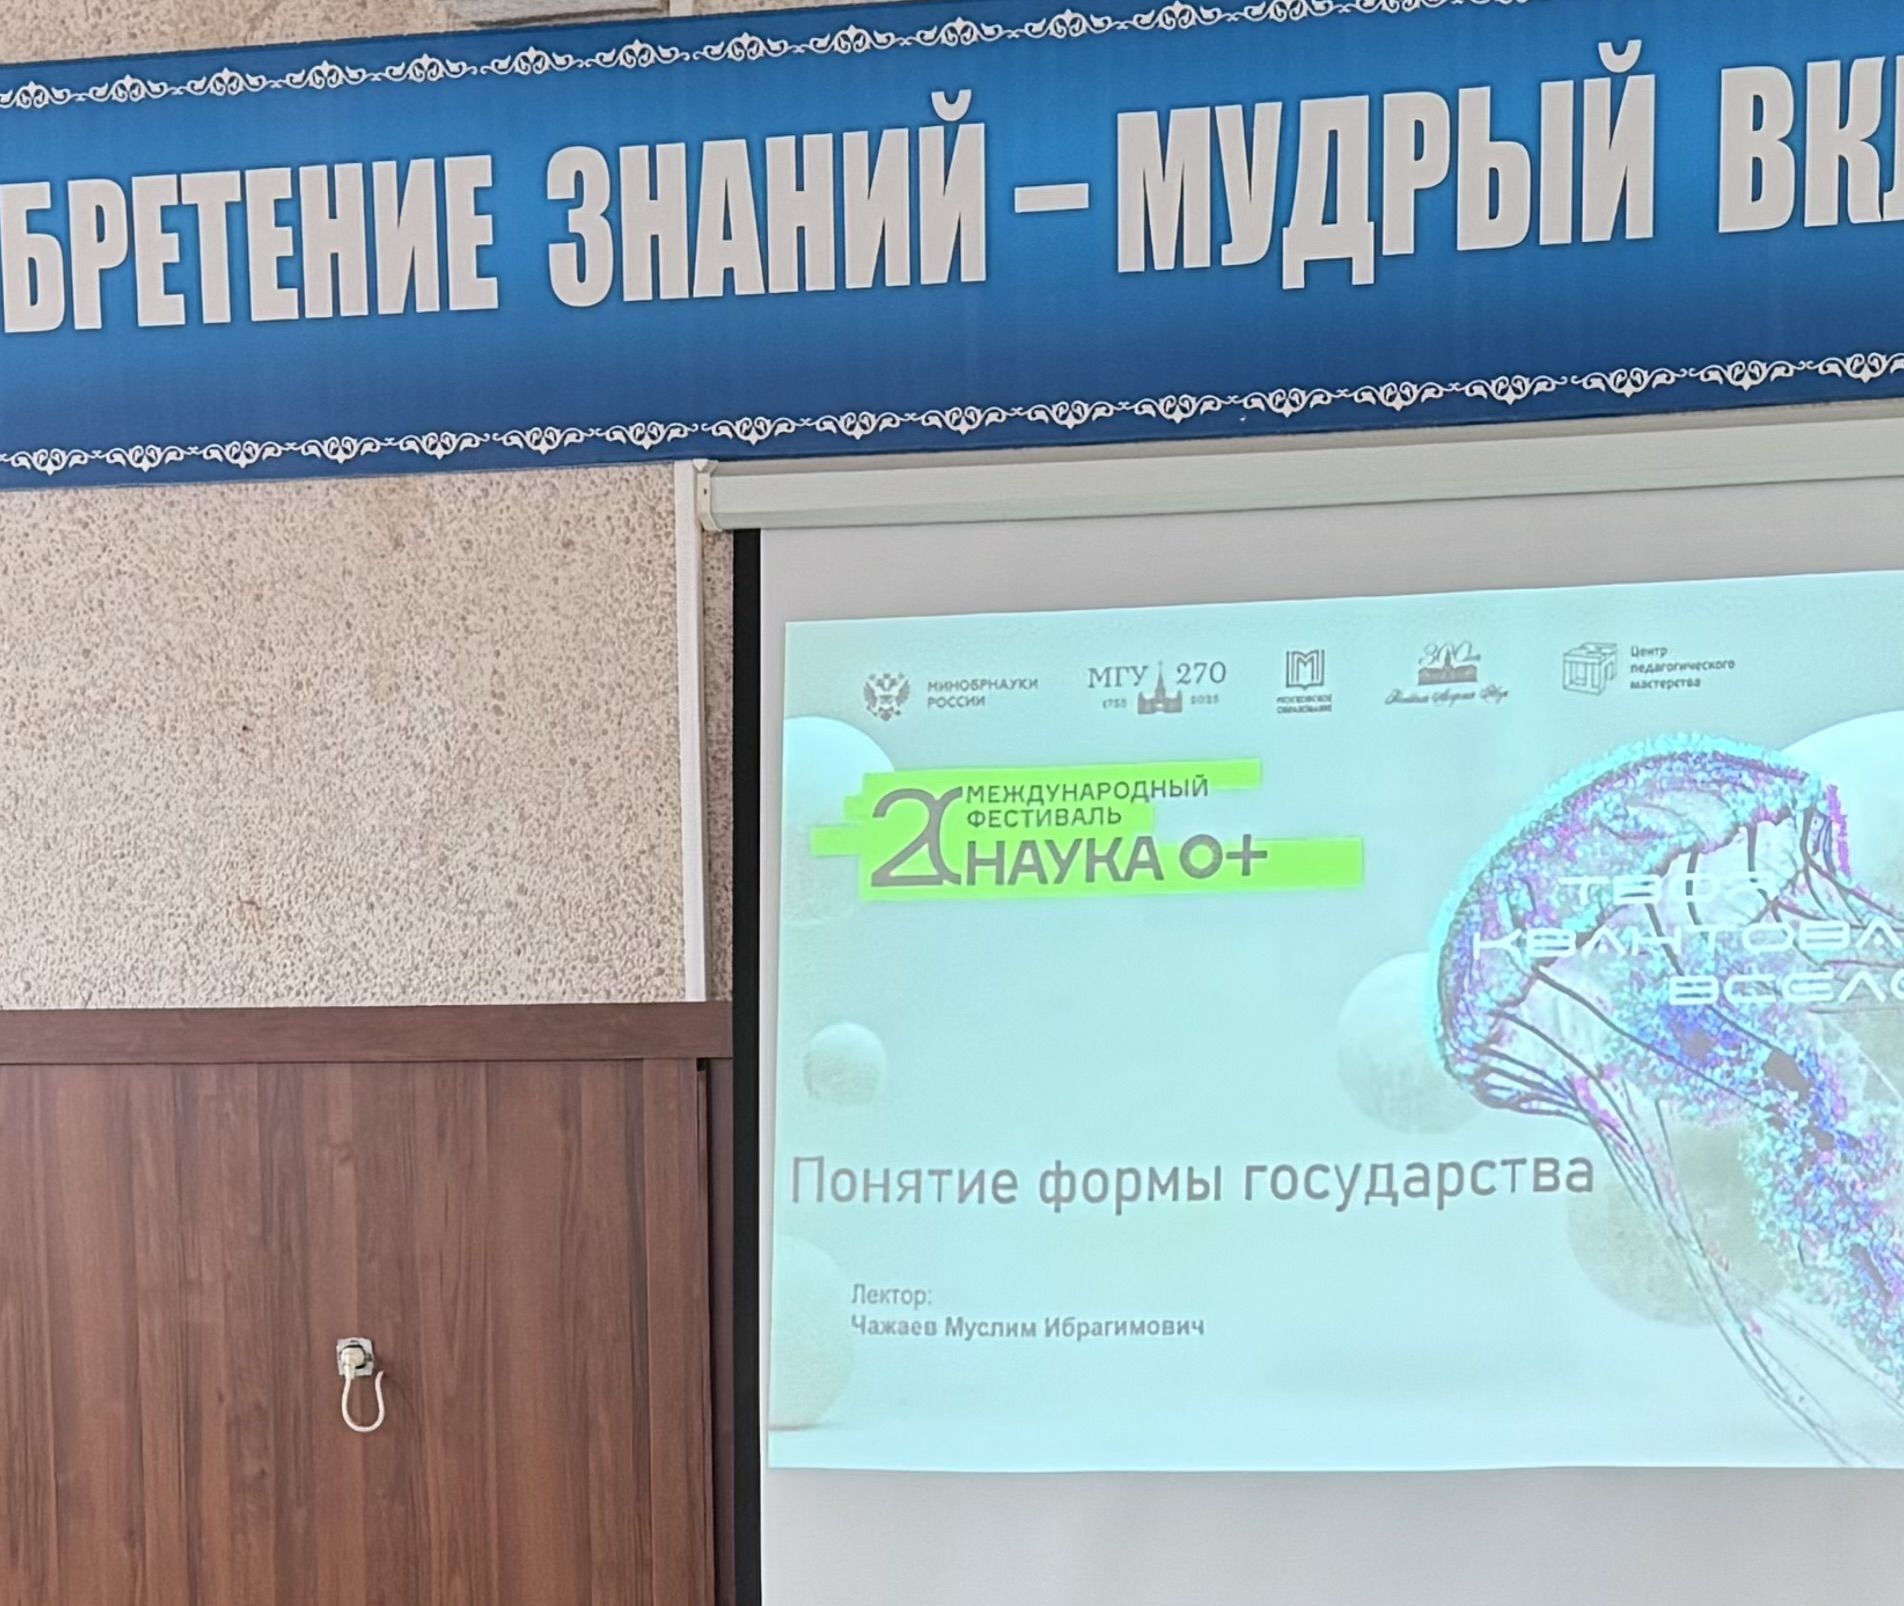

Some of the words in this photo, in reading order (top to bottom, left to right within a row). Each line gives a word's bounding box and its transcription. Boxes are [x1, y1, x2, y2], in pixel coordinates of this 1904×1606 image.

[547, 89, 986, 307] ЗНАНИЙ
[1117, 39, 1655, 290] МУДРЫЙ
[1630, 645, 1669, 658] Центр
[1088, 666, 1149, 688] МГУ
[1176, 660, 1228, 686] 270
[1630, 659, 1737, 674] педагогического
[927, 677, 1039, 692] МИНОБРНАУКИ
[1630, 677, 1702, 690] мастерства
[927, 695, 986, 709] РОССИИ
[965, 774, 1209, 806] МЕЖДУНАРОДНЫЙ
[966, 806, 1122, 829] ФЕСТИВАЛЬ
[965, 835, 1165, 887] НАУКА
[791, 1155, 1019, 1205] Понятие
[1038, 1159, 1223, 1217] формы
[1244, 1154, 1595, 1213] государства
[850, 1283, 932, 1310] Лектор:
[850, 1314, 938, 1337] Чажаев
[944, 1316, 1037, 1341] Муслим
[1044, 1316, 1205, 1341] Ибрагимович
